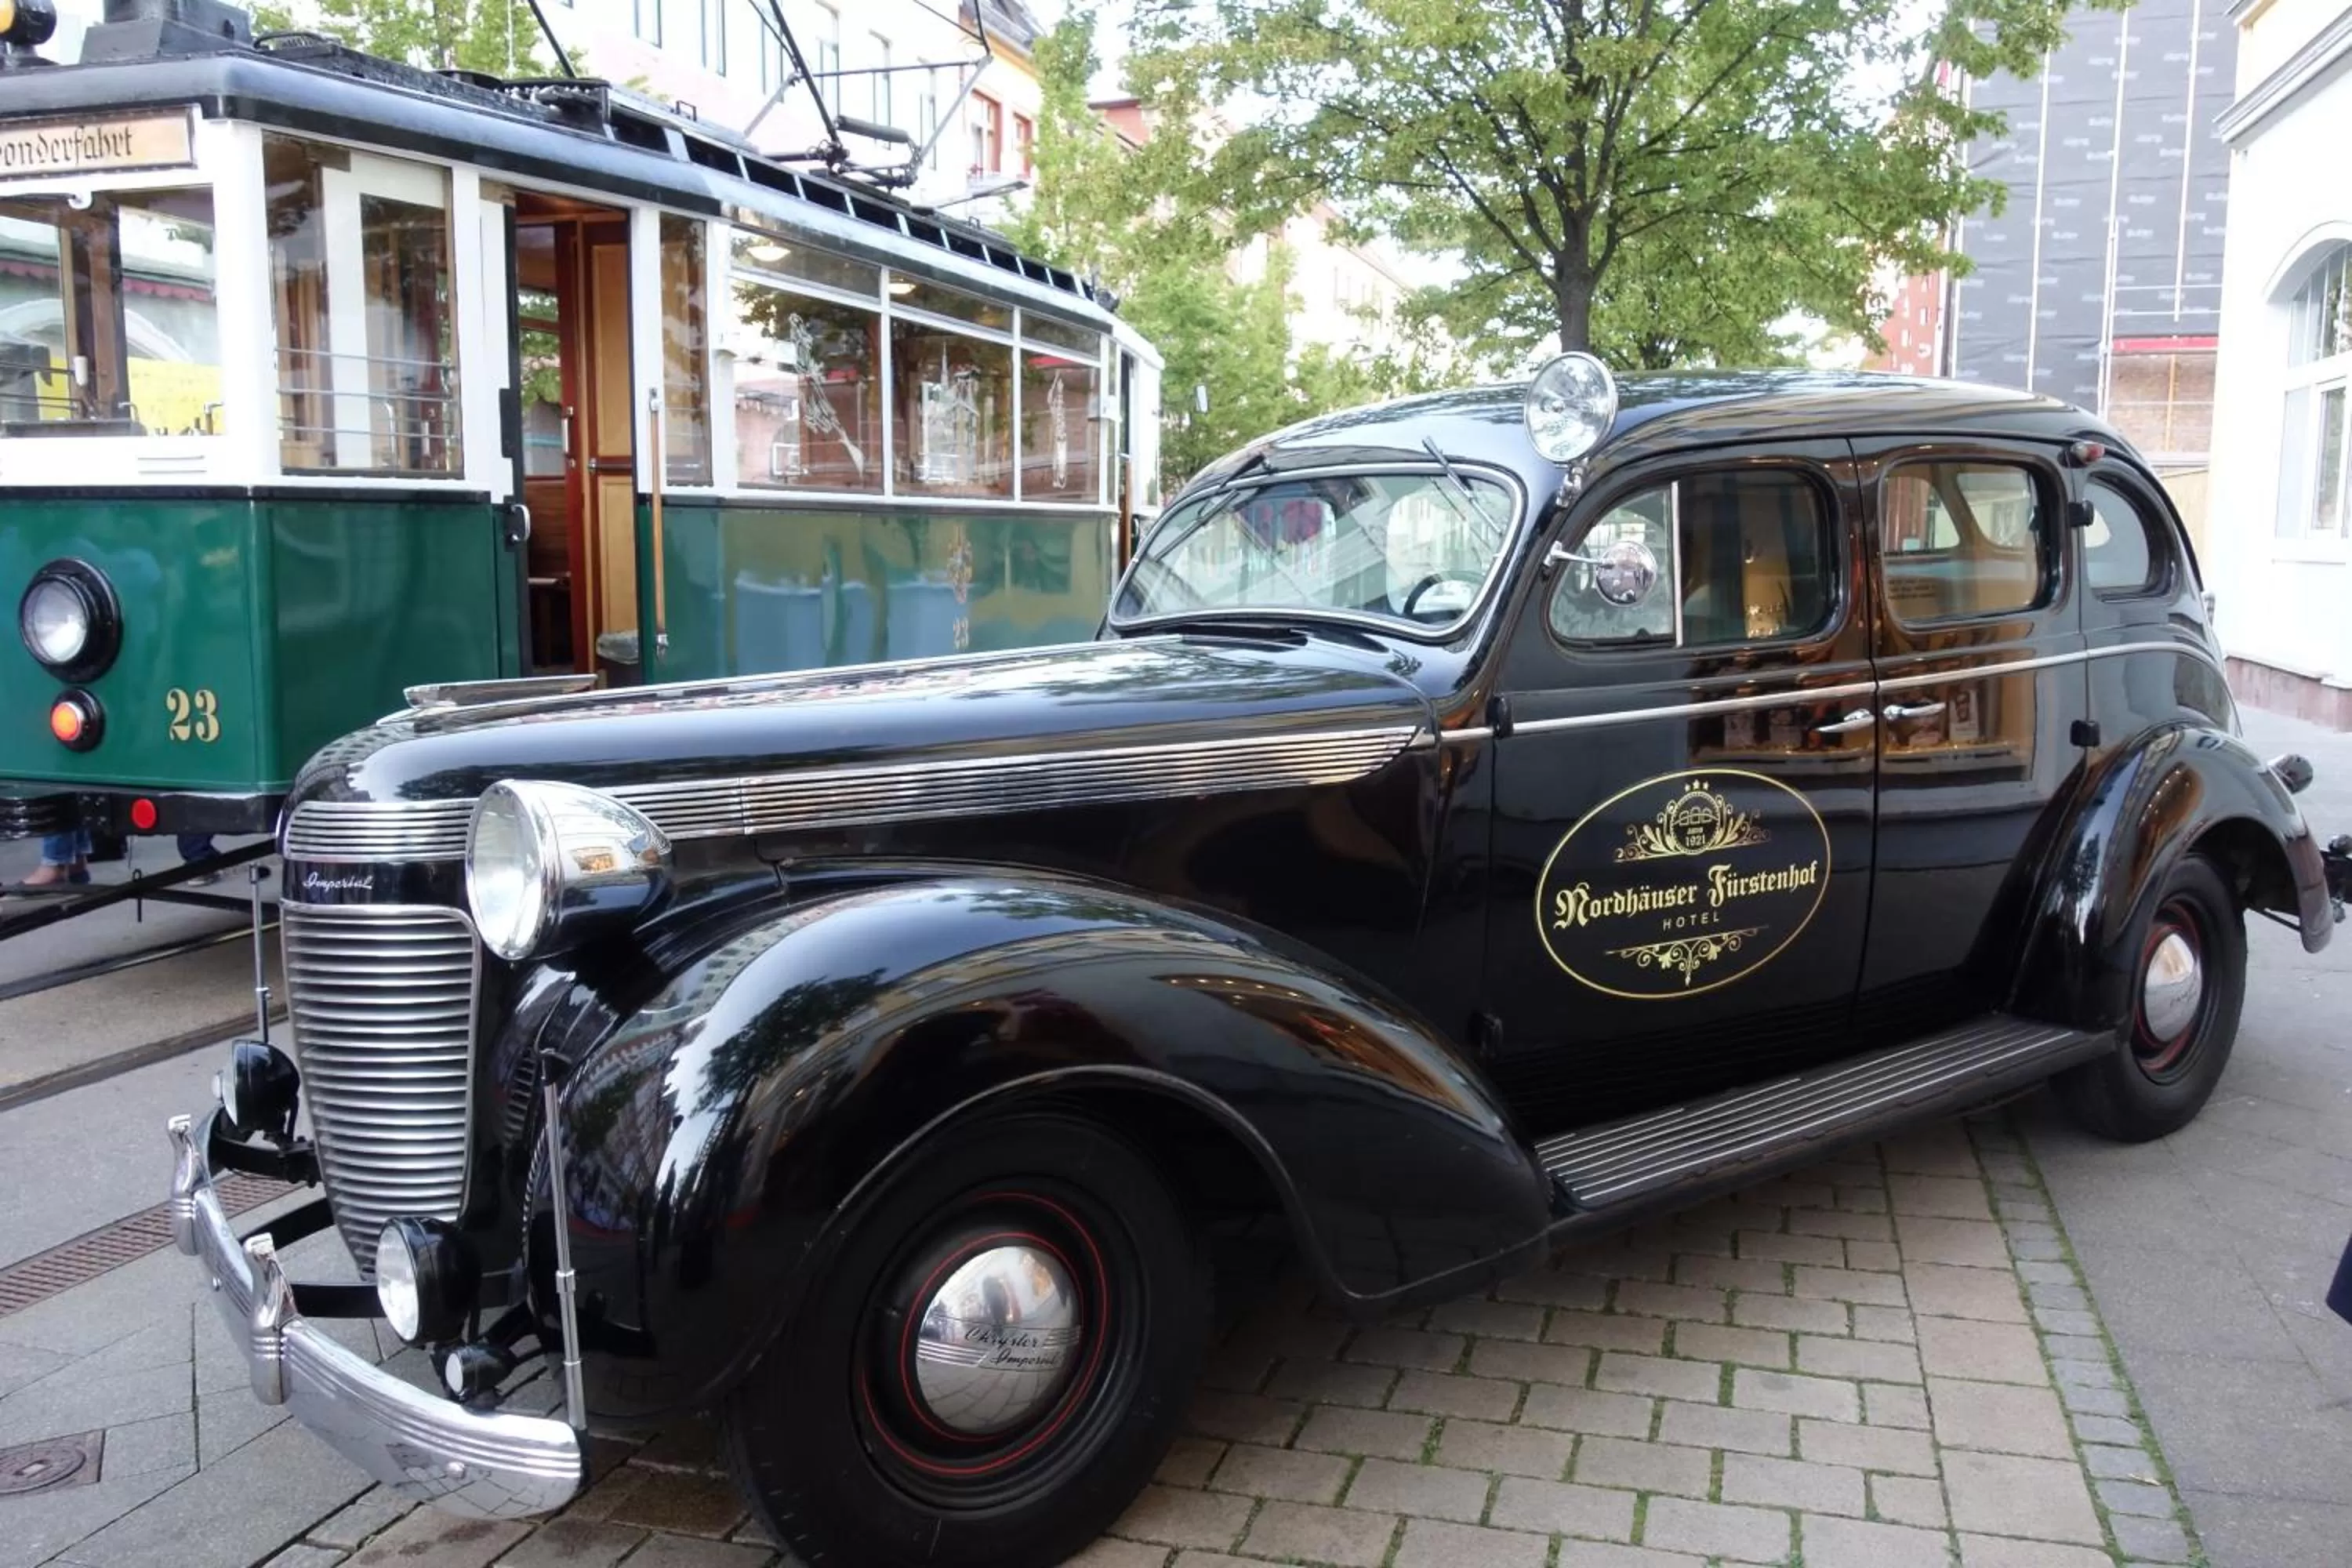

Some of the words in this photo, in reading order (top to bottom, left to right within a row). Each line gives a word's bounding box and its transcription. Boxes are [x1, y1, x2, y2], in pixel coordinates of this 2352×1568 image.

[0, 125, 132, 166] onderfahrt
[166, 687, 220, 742] 23
[302, 871, 373, 892] Imperial
[1553, 881, 1698, 929] Nordhäuser
[1707, 860, 1818, 908] Fürstenhof
[1662, 911, 1720, 931] HOTEL
